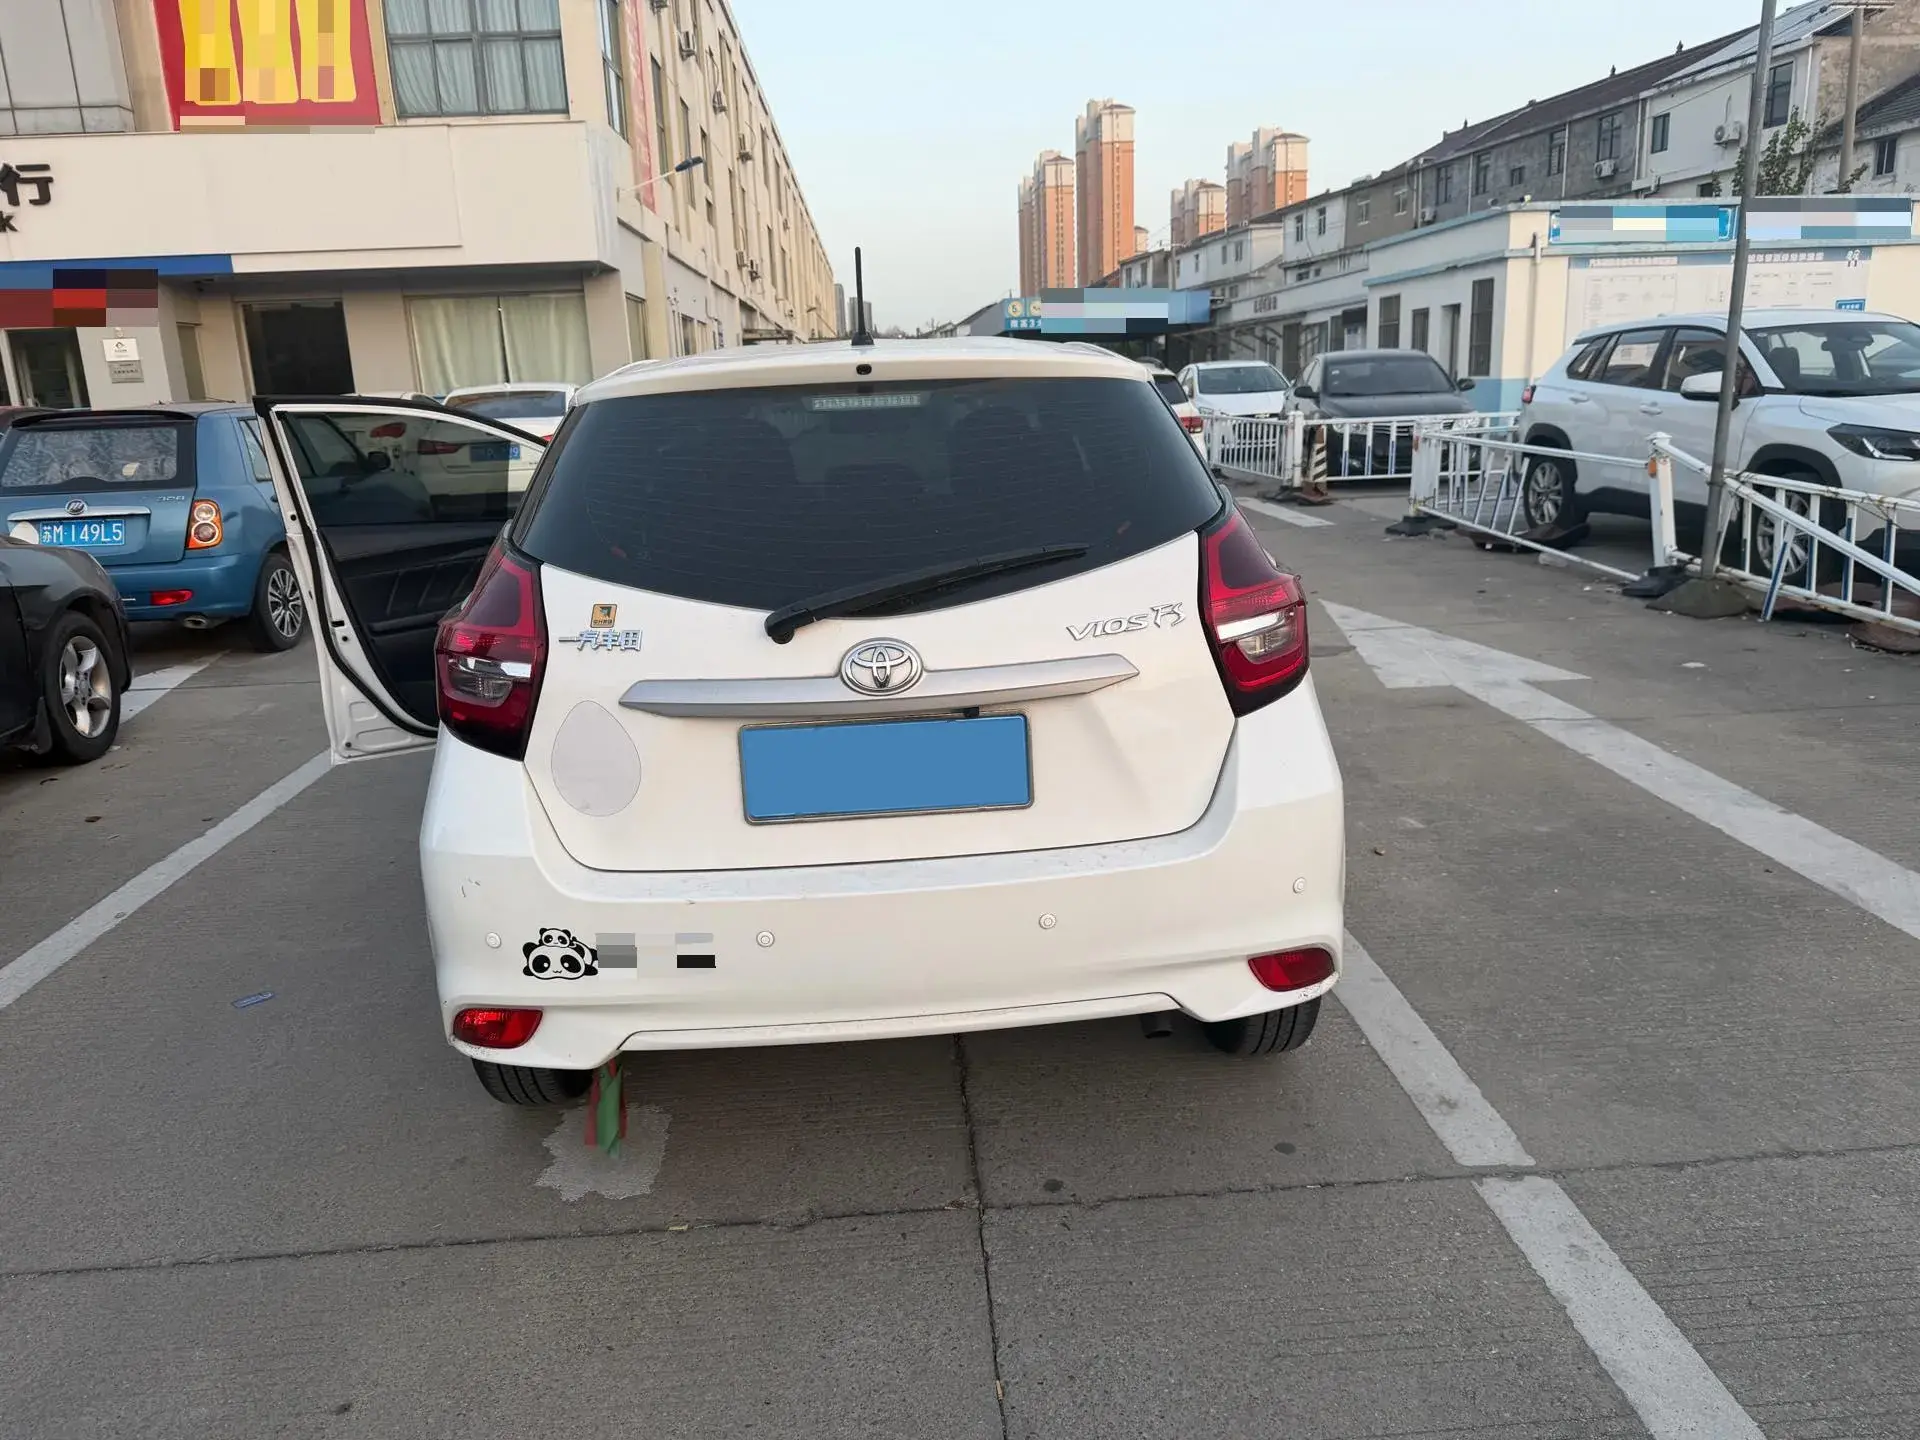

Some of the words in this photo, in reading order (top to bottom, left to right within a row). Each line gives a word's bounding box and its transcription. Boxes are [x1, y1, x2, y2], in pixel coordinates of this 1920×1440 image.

[0, 163, 54, 207] 行
[559, 630, 642, 651] 一汽丰田
[1066, 613, 1148, 641] VIOS
